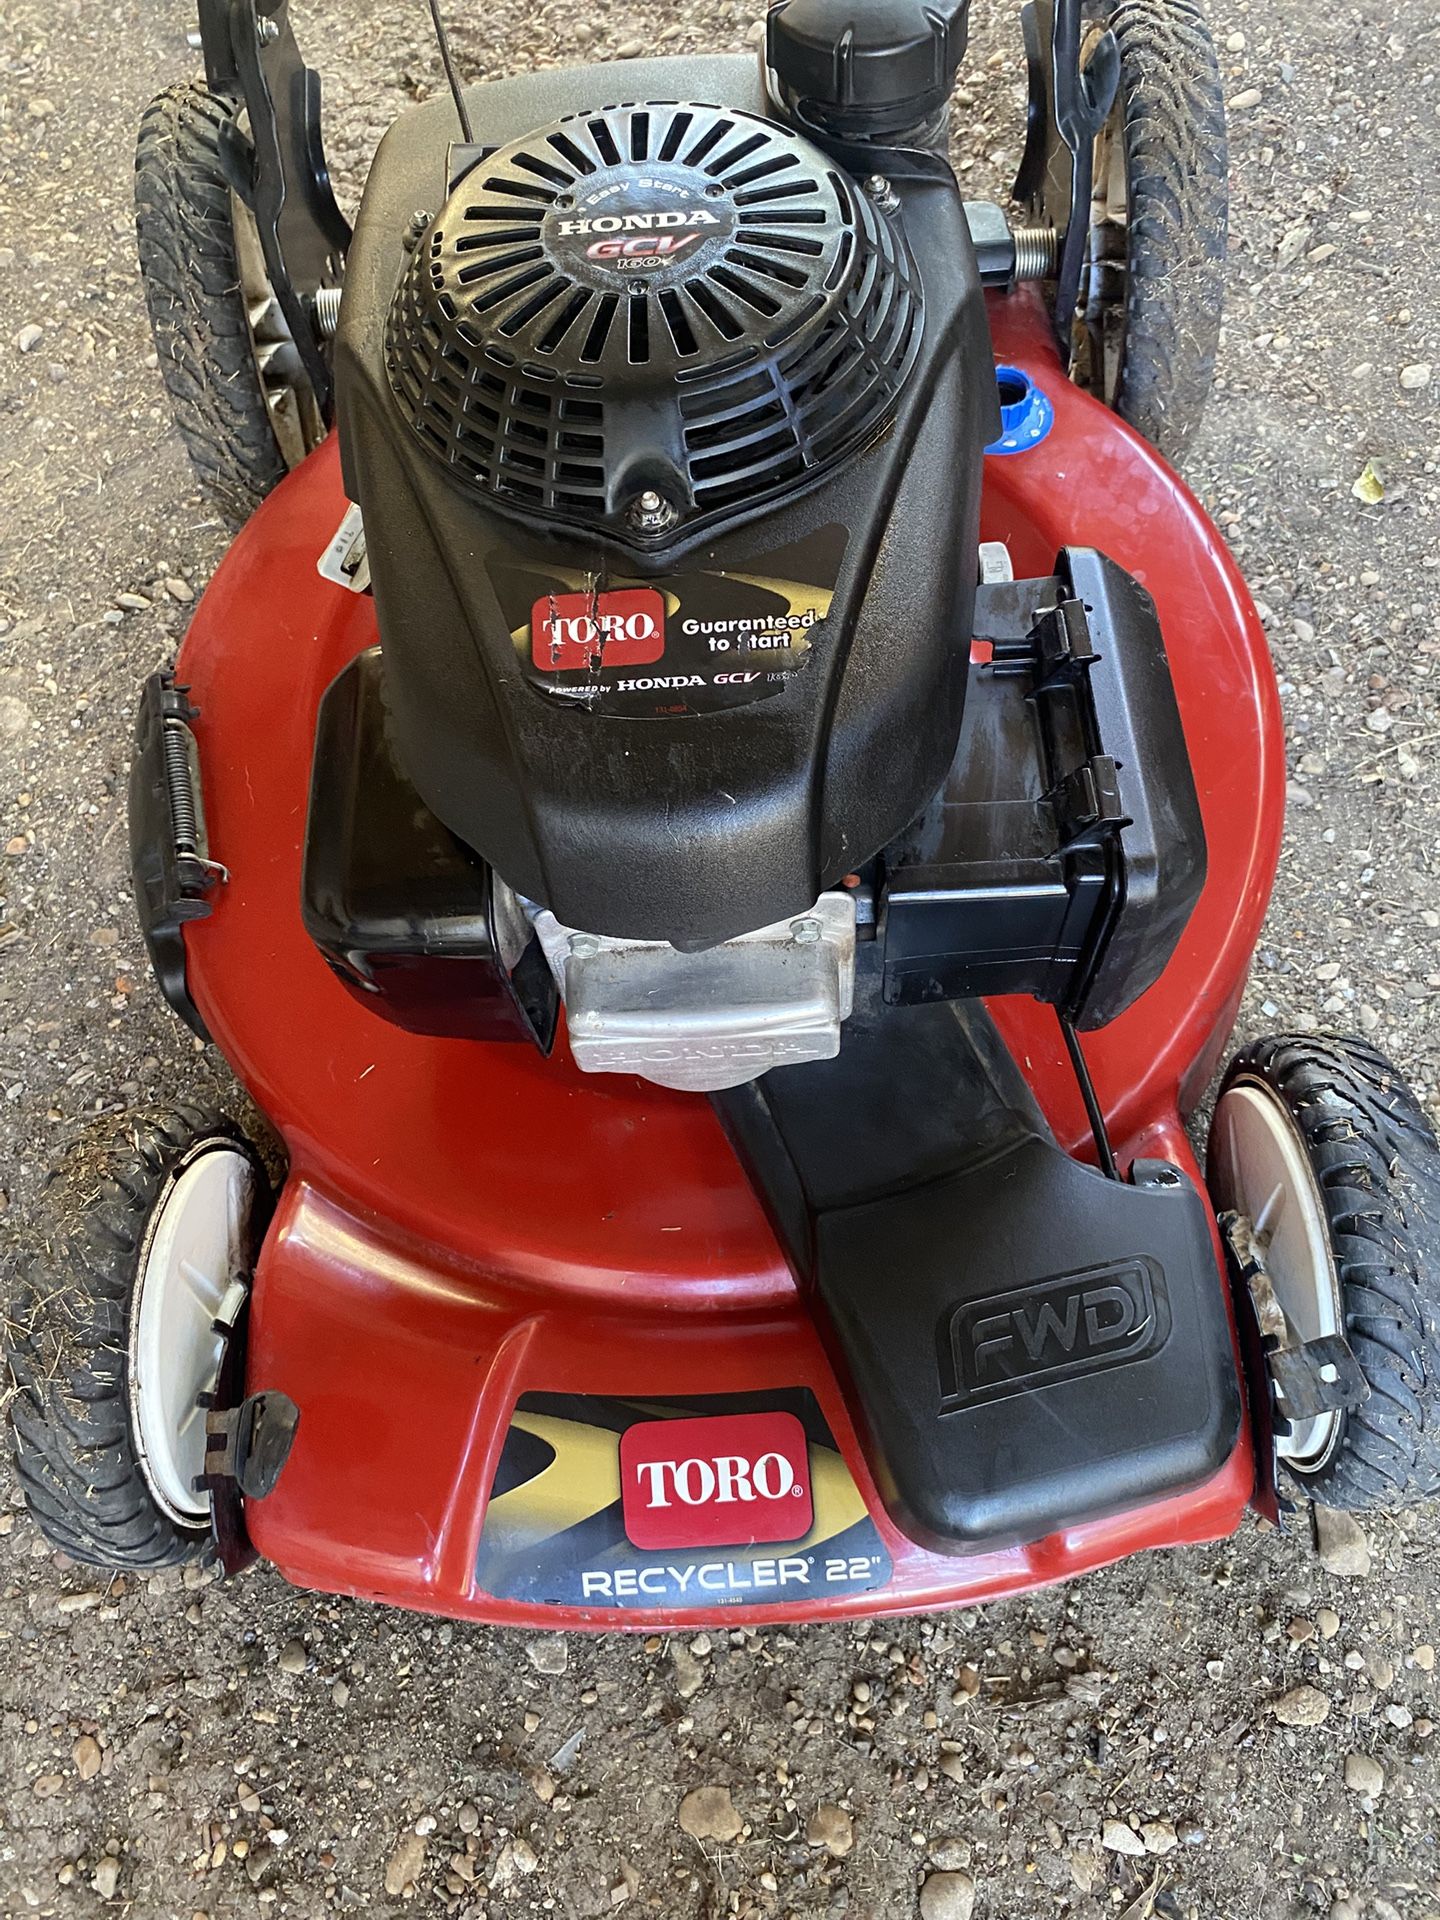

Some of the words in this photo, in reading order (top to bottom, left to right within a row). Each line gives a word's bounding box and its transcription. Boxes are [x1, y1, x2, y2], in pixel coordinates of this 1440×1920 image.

[586, 181, 630, 205] Easy
[638, 178, 690, 200] Start
[557, 210, 720, 237] HONDA
[586, 232, 702, 260] GCV
[616, 256, 661, 270] 160
[682, 609, 816, 635] Guaranteed
[708, 637, 731, 652] to
[549, 684, 598, 695] POWERED
[600, 684, 612, 695] by
[616, 674, 708, 692] HONDA
[713, 671, 762, 685] GCV
[971, 1284, 1136, 1377] FWD
[825, 1556, 881, 1582] 22"
